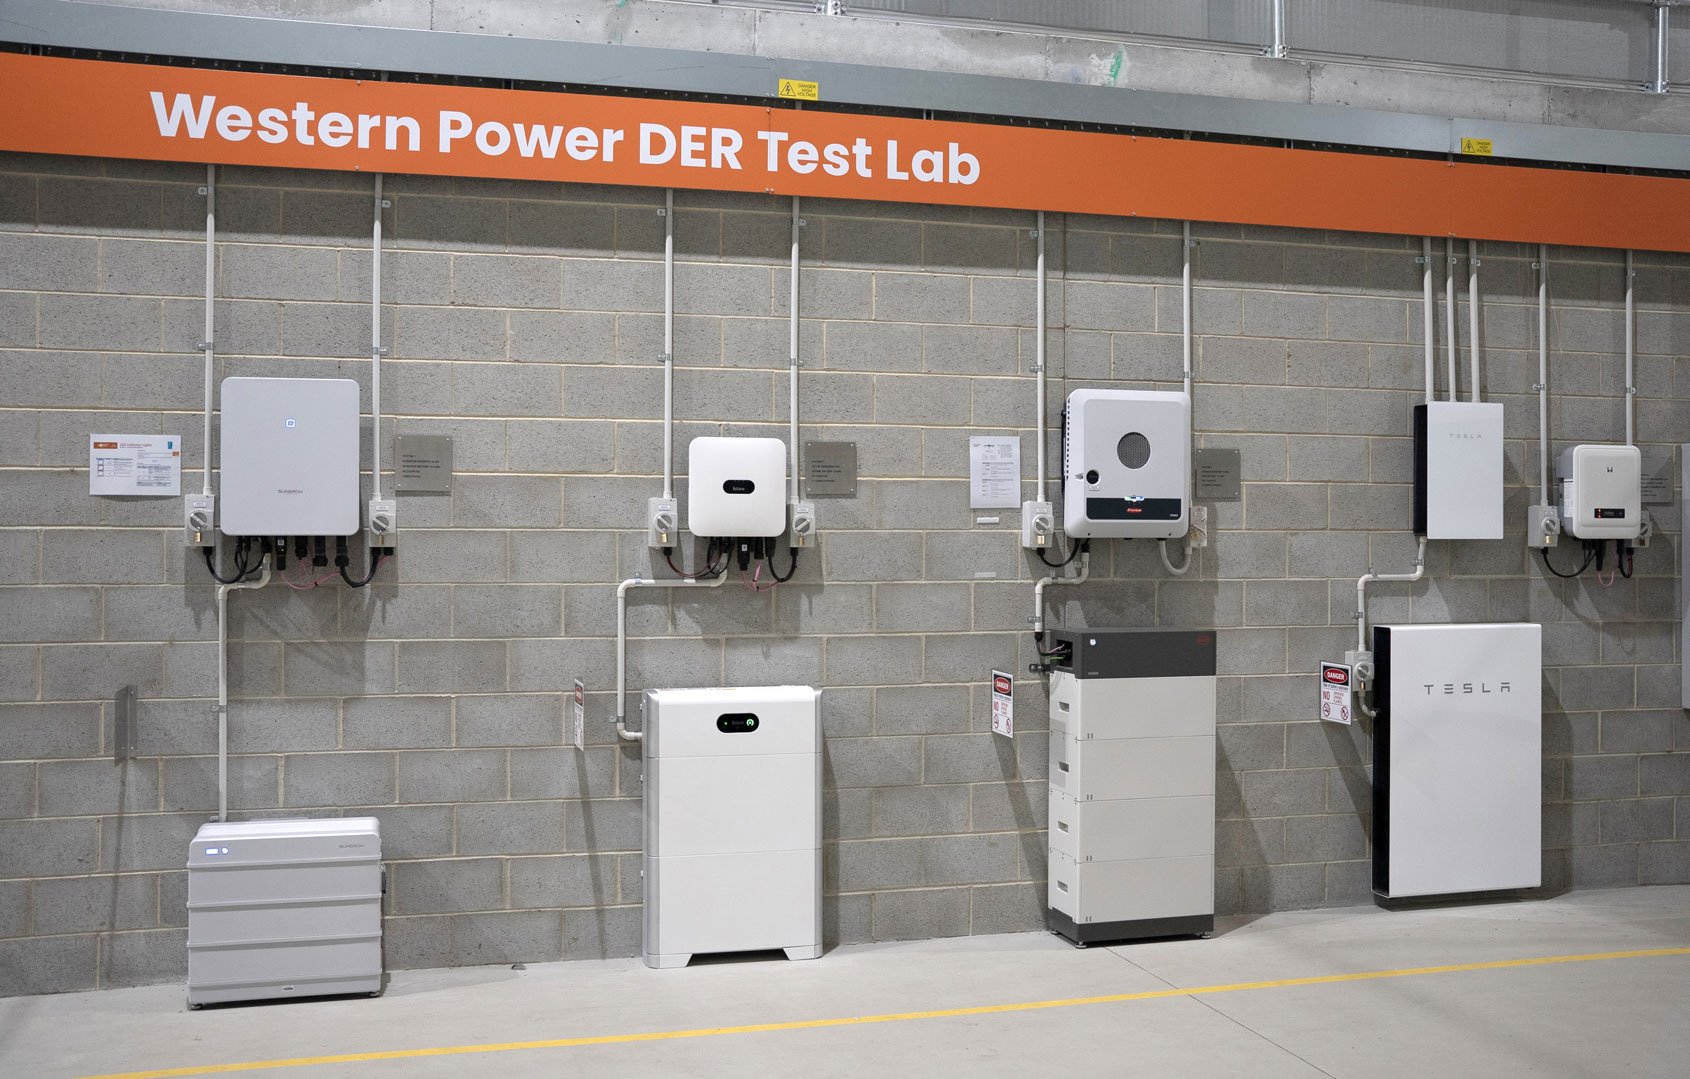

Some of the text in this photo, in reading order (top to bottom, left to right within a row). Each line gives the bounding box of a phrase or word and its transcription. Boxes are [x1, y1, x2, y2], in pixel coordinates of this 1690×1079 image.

[149, 91, 981, 186] Western Power DER Test Lab
[1326, 671, 1345, 681] DANGER
[1423, 681, 1511, 695] TESLA
[1323, 691, 1330, 701] NO
